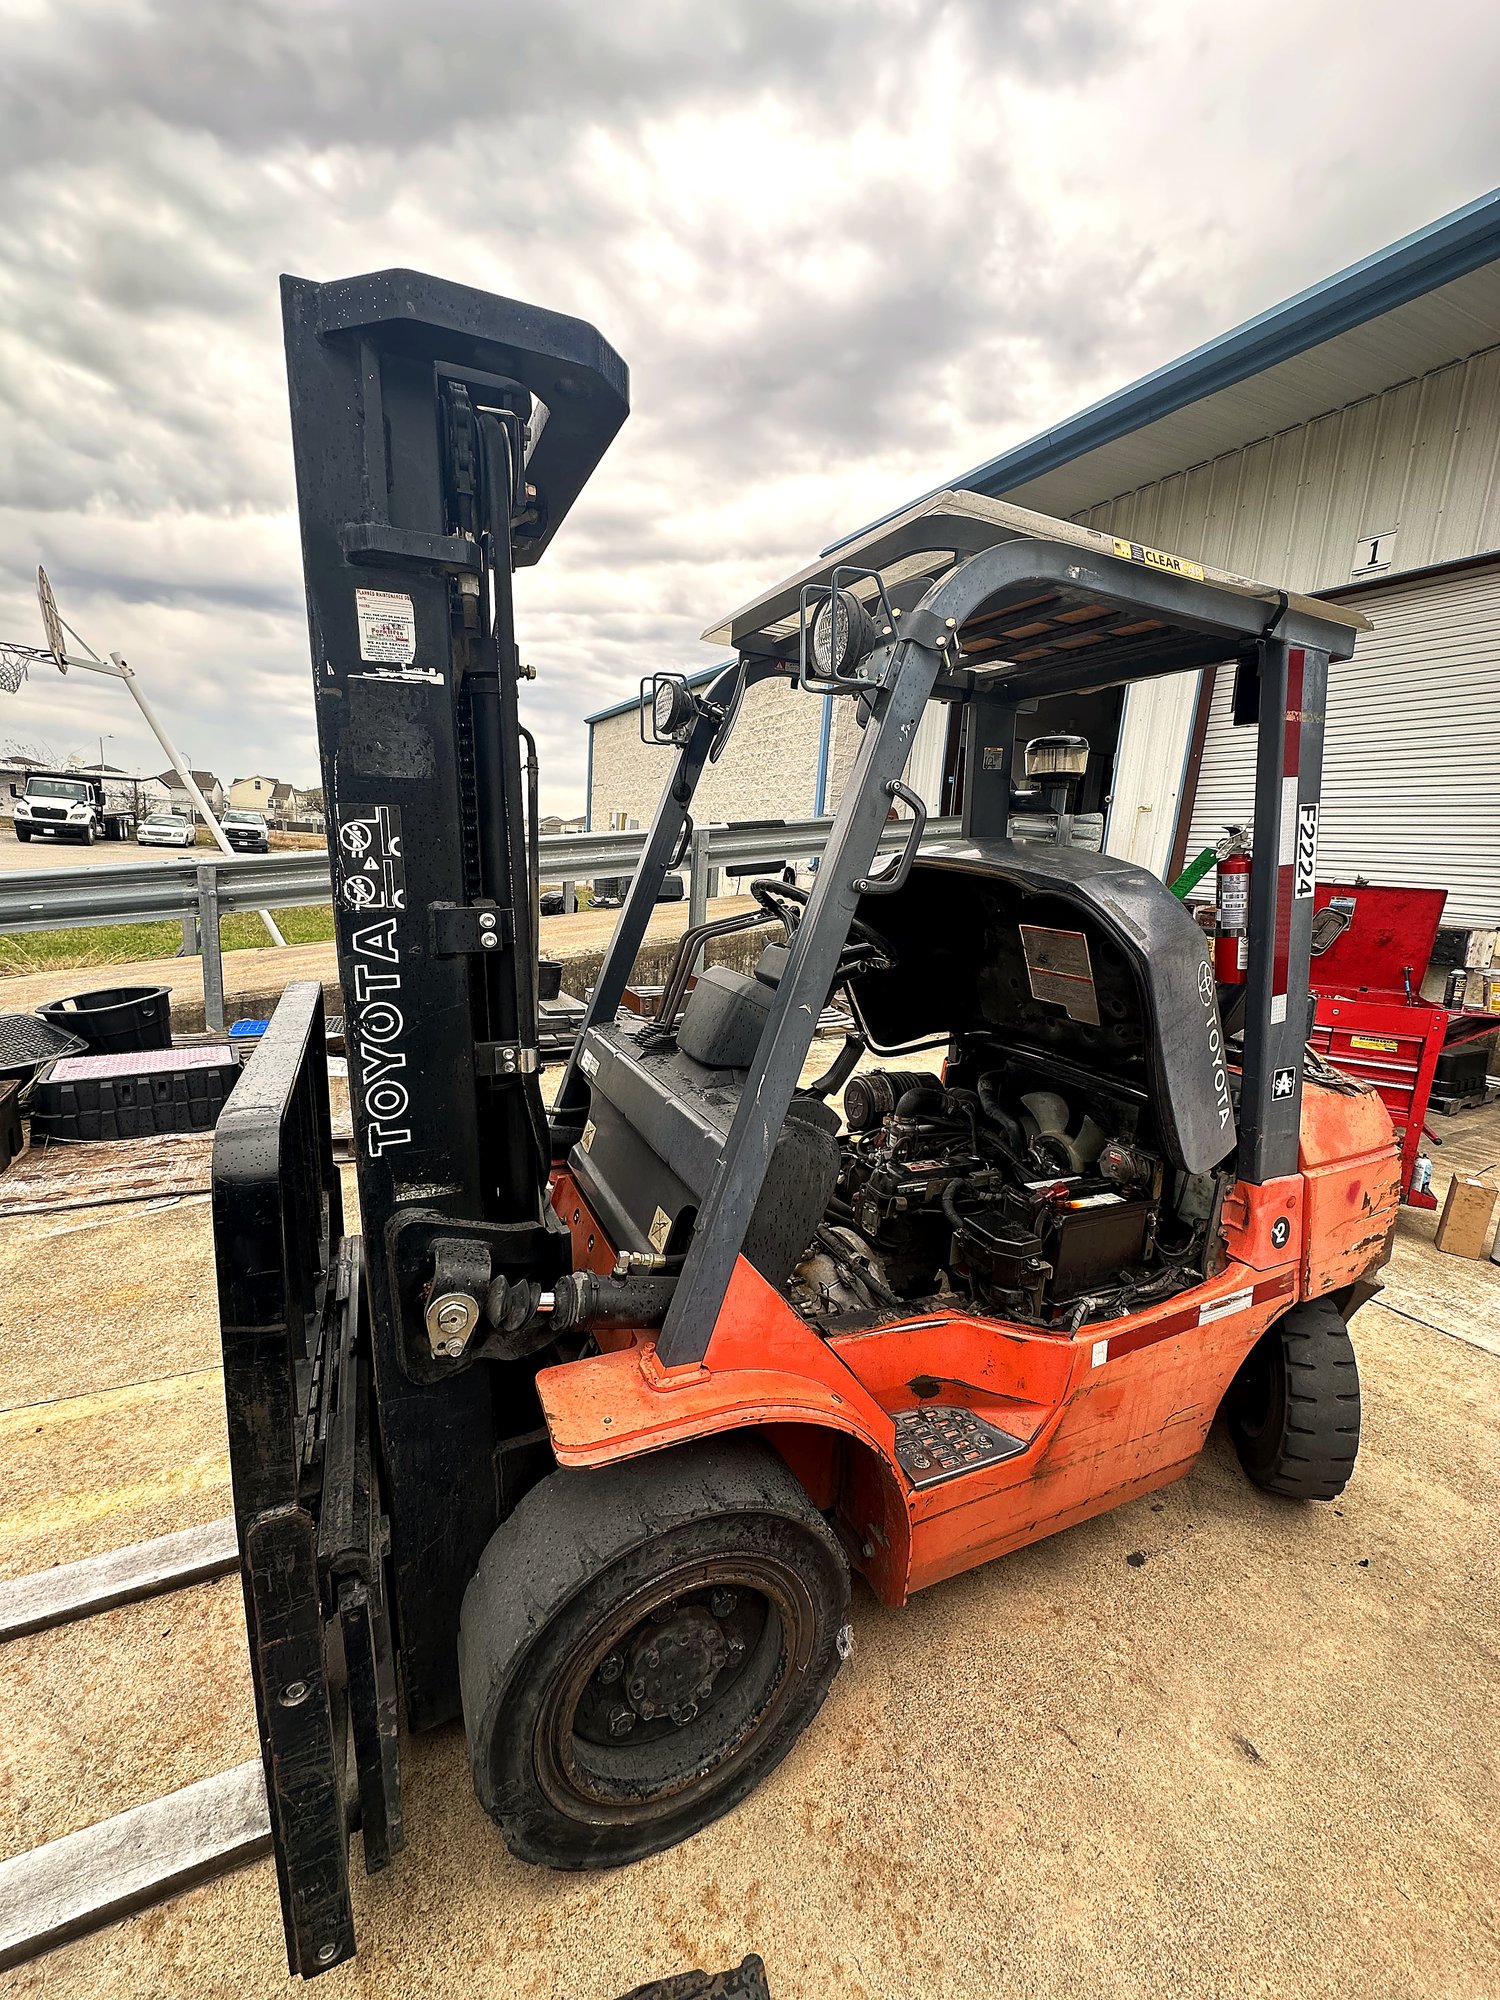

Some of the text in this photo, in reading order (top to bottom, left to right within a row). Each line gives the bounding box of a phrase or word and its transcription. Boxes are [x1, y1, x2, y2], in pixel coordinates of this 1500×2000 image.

[1367, 539, 1380, 566] 1
[1296, 805, 1317, 897] F2224
[352, 917, 412, 1158] TOYOTA
[1205, 1007, 1231, 1131] TOYOTA
